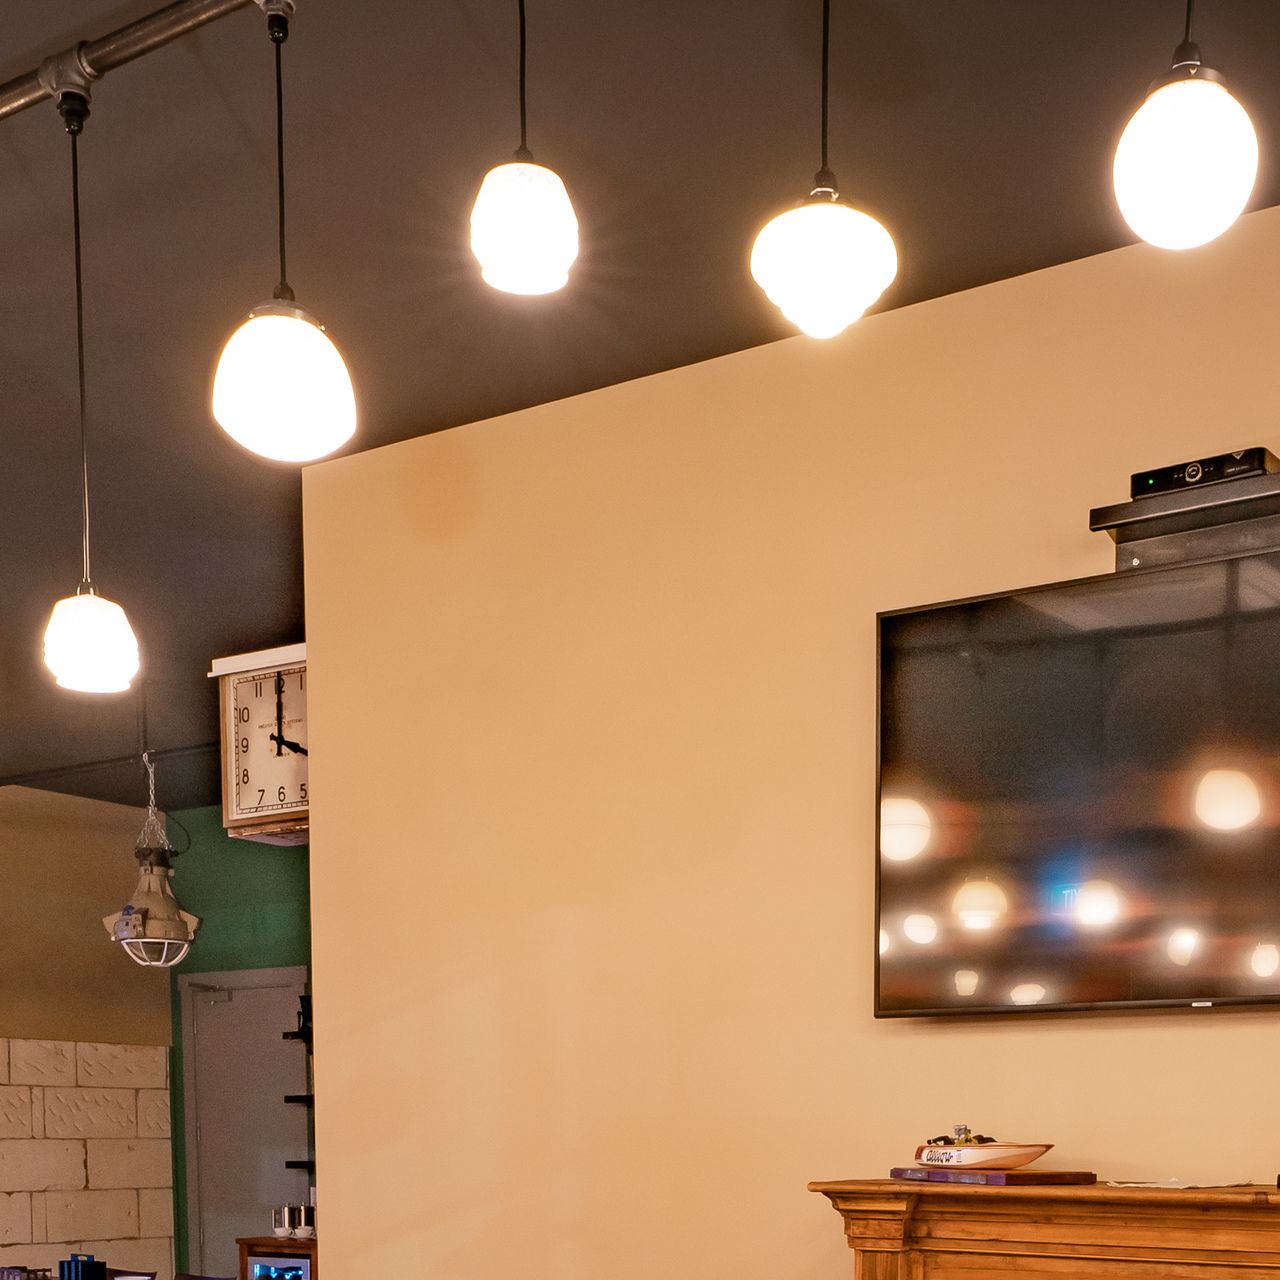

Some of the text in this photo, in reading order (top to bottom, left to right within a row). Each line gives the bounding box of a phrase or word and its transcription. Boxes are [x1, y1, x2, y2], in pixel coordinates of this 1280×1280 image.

[238, 706, 250, 724] 10
[241, 736, 250, 754] 9
[241, 768, 250, 785] 8
[257, 789, 266, 806] 7
[277, 786, 286, 803] 6
[299, 783, 308, 800] 5
